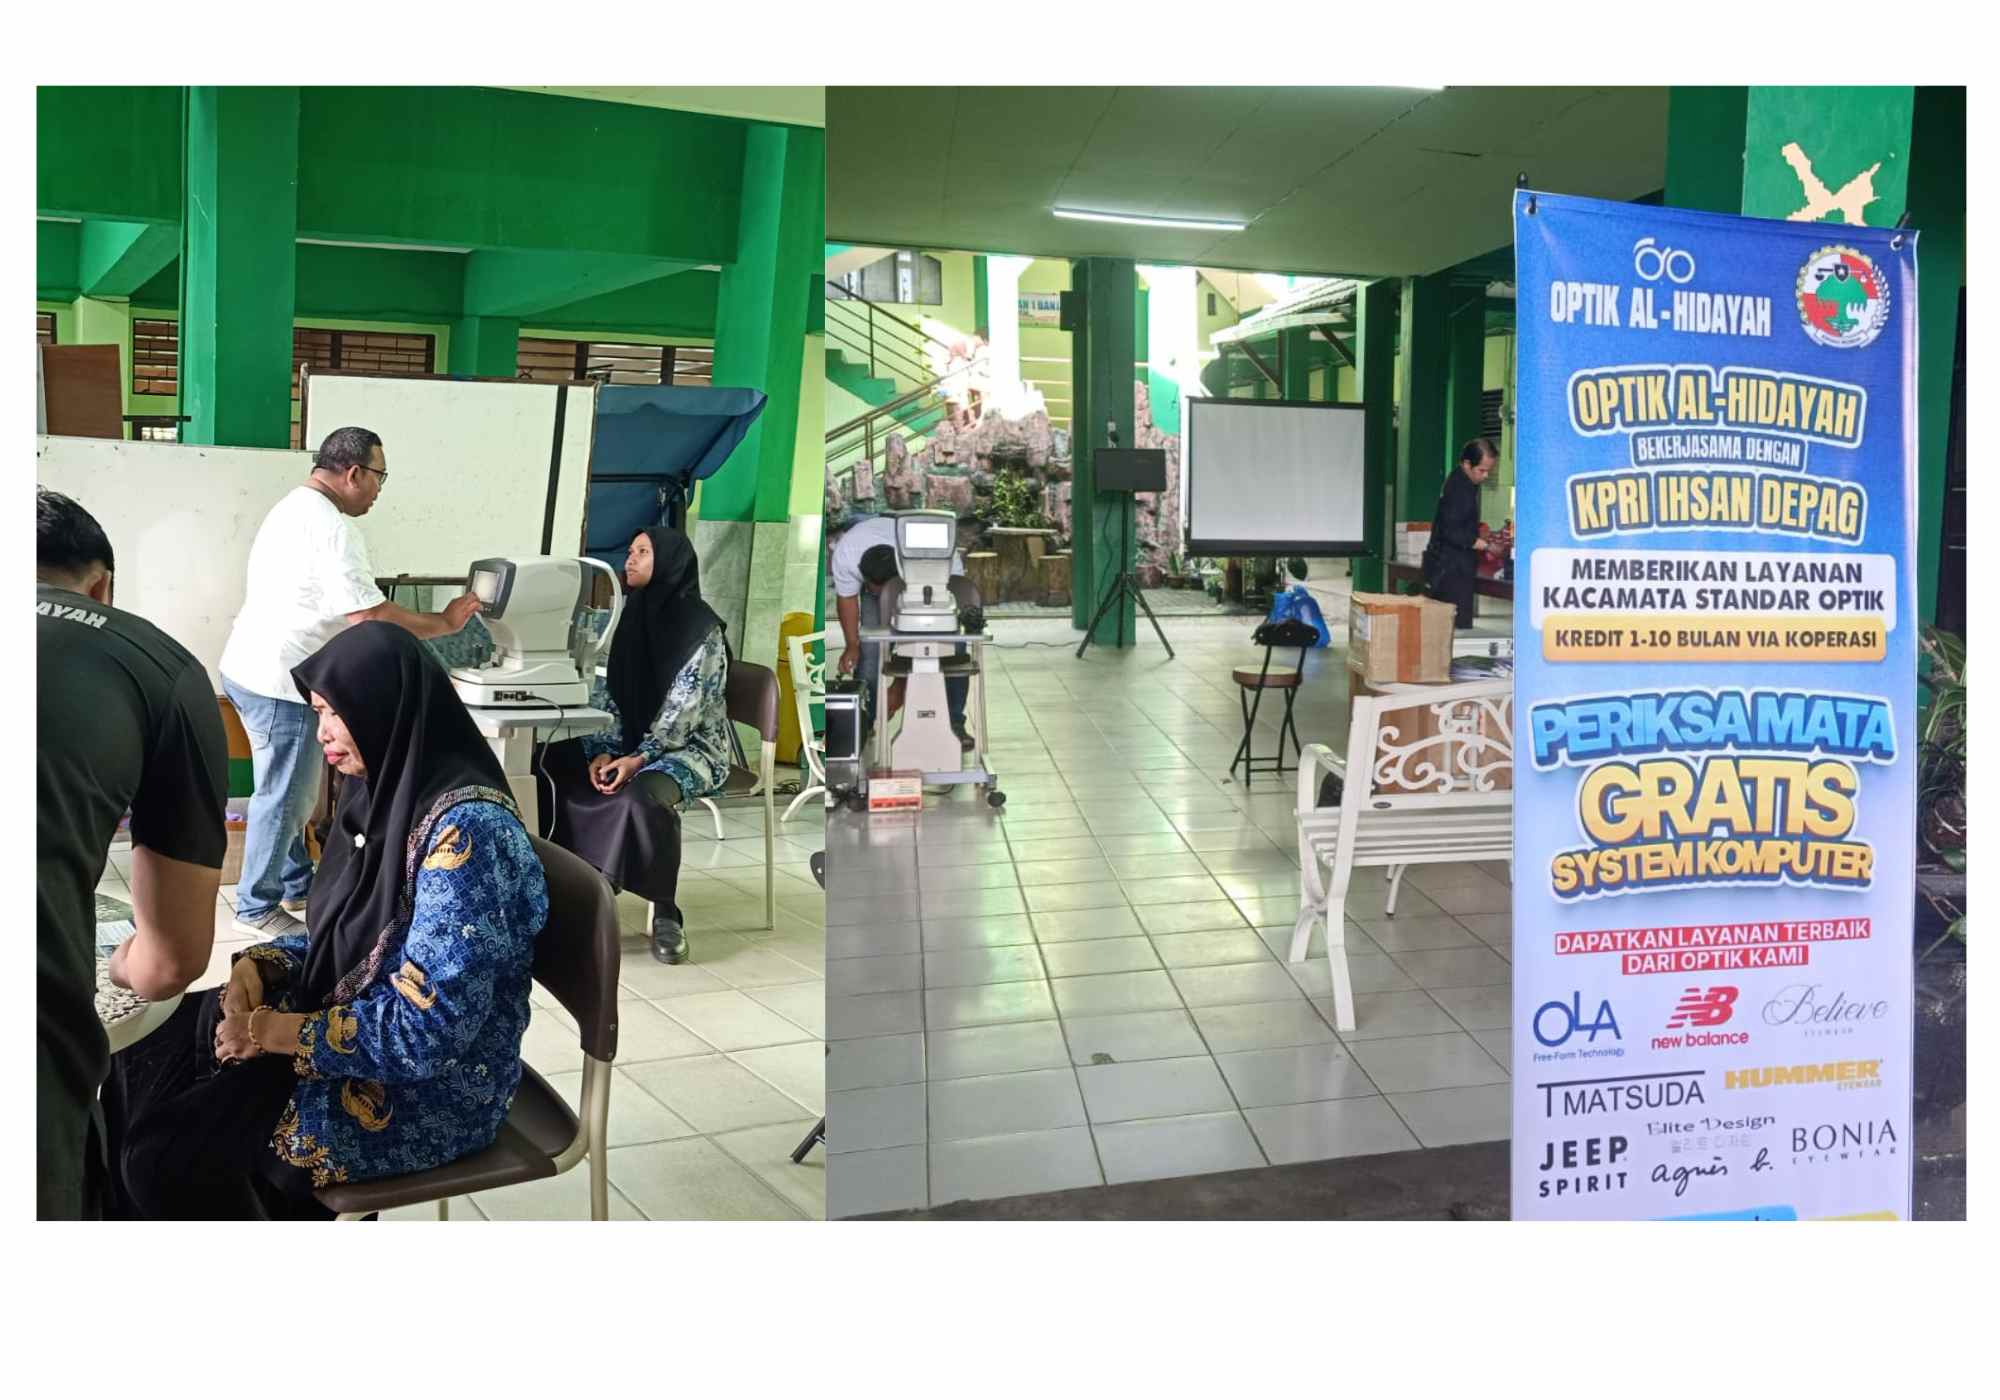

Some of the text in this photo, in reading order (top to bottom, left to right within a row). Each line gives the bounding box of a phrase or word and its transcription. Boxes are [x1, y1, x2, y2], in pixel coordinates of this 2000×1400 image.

[1550, 281, 1772, 338] OPTIK AL-HIDAYAH
[1576, 373, 1858, 438] OPTIK AL-HIDAYAH
[1637, 435, 1801, 467] BEKERJASAMA DENGAN
[1575, 475, 1859, 537] KPRI IHSAN DEPAG
[1571, 558, 1863, 584] MEMBERIKAN LAYANAN
[1542, 586, 1885, 612] KACAMATA STANDAR OPTIK
[1555, 629, 1877, 649] KREDIT 1-10 BULAN VIA KOPERASI
[1532, 693, 1896, 758] PERIKSA MATA
[1580, 757, 1858, 845] GRATIS
[1552, 839, 1873, 893] SYSTEM KOMPUTER
[1556, 919, 1870, 954] DAPATKAN LAYANAN TERBAIK
[1627, 945, 1804, 974] DARI OPTIK KAMI
[1761, 983, 1888, 1026] Believe
[1651, 1030, 1749, 1050] new balance
[1724, 1059, 1879, 1090] HUMMER
[1700, 1115, 1776, 1131] Design
[1792, 1118, 1897, 1152] BONIA
[1539, 1135, 1629, 1171] JEEP
[1539, 1172, 1628, 1198] SPIRIT
